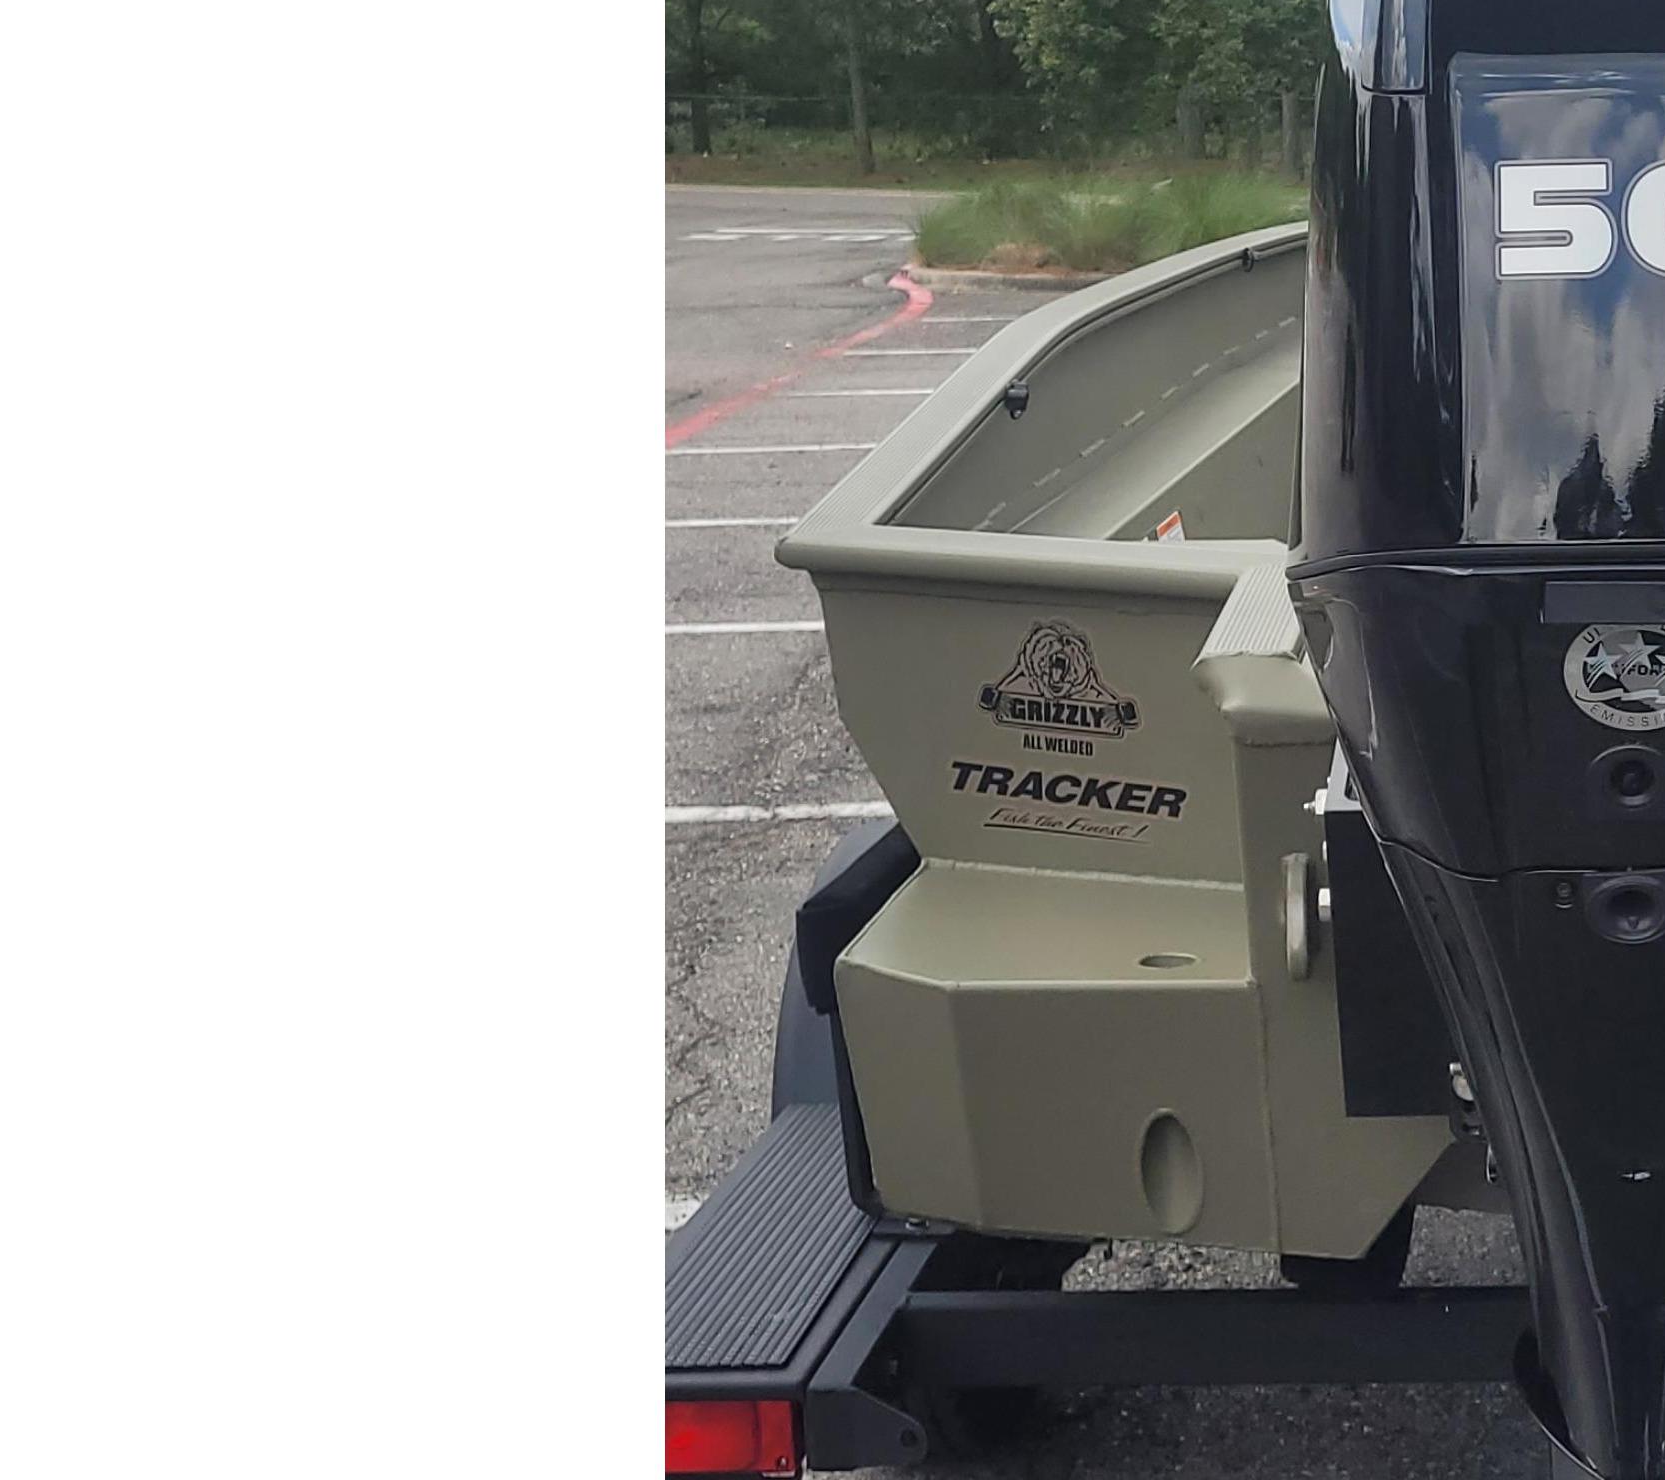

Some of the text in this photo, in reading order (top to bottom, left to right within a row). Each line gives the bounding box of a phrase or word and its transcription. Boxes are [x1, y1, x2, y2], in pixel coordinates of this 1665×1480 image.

[1009, 697, 1106, 728] GRIZZLY
[1023, 733, 1094, 757] ALL WELDED
[951, 761, 1188, 818] TRACKER
[989, 807, 1031, 824] Fish
